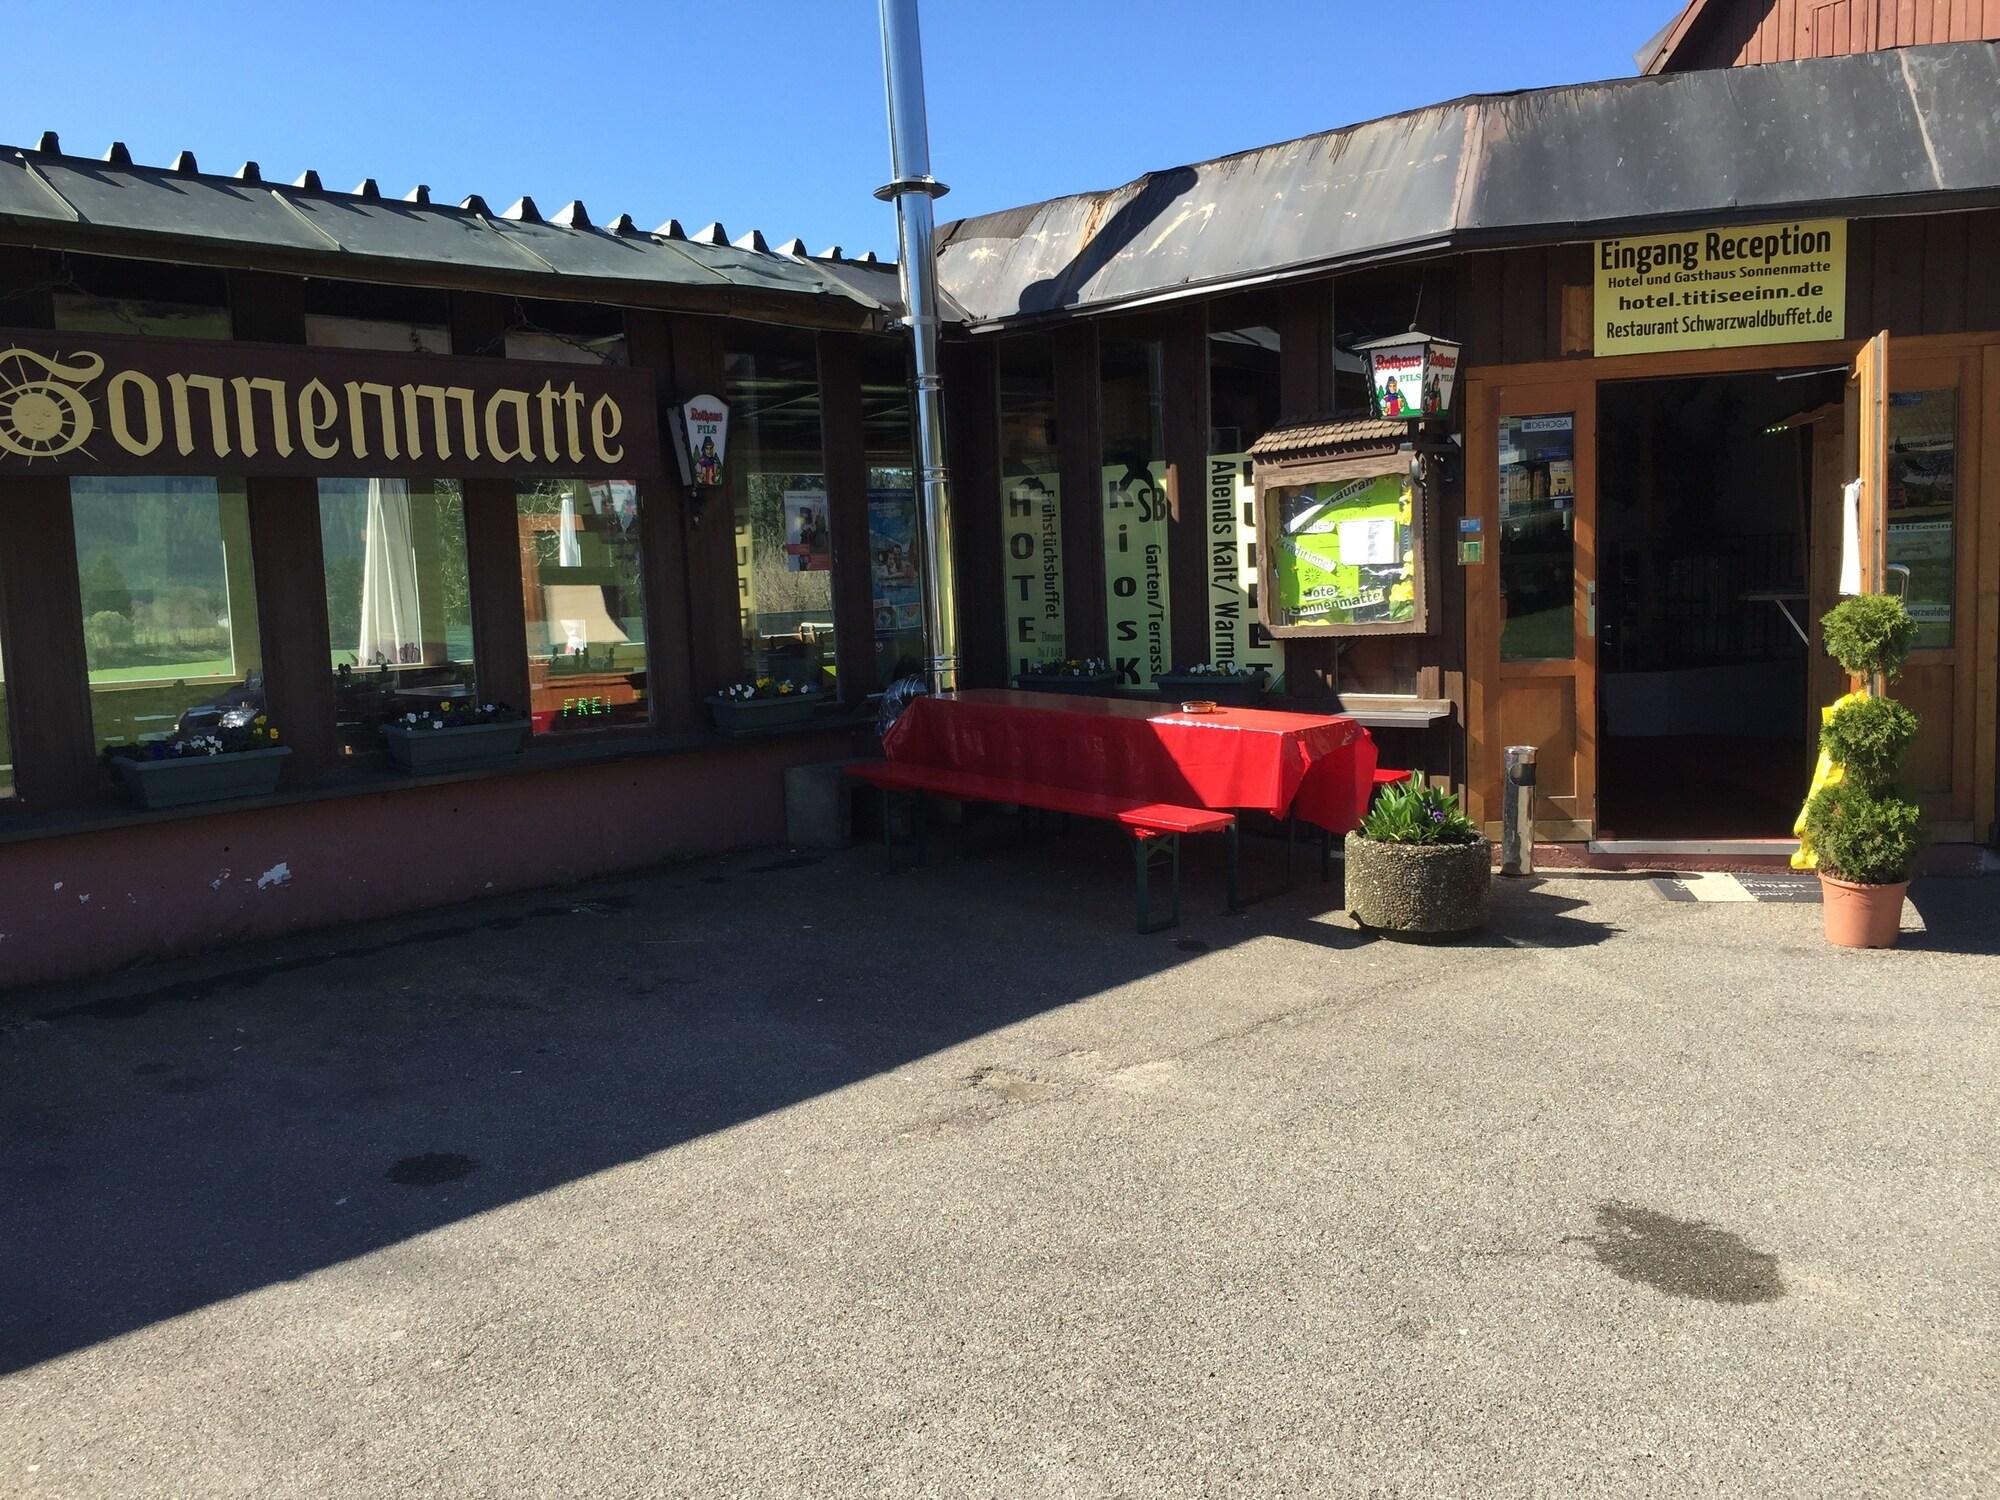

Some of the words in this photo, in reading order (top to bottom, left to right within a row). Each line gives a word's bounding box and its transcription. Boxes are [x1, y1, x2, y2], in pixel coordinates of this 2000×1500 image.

[1601, 240, 1699, 274] Eingang
[1705, 225, 1831, 264] Reception
[1608, 271, 1643, 289] Hotel
[1647, 274, 1671, 286] und
[1674, 269, 1736, 284] Gasthaus
[1739, 261, 1831, 278] Sonnenmatte
[1619, 282, 1823, 311] hotel.titiseeinn.de
[1607, 316, 1679, 339] Restaurant
[1682, 306, 1832, 333] Schwarzwaldbuffet.de
[1399, 374, 1422, 382] PILS
[0, 346, 624, 464] Sonnenmatte
[697, 424, 718, 434] PILS
[1531, 418, 1569, 431] DEHOGA
[1138, 487, 1167, 523] SB
[1211, 460, 1236, 534] Abends
[1211, 541, 1239, 594] Kalt/
[562, 696, 613, 719] FREI
